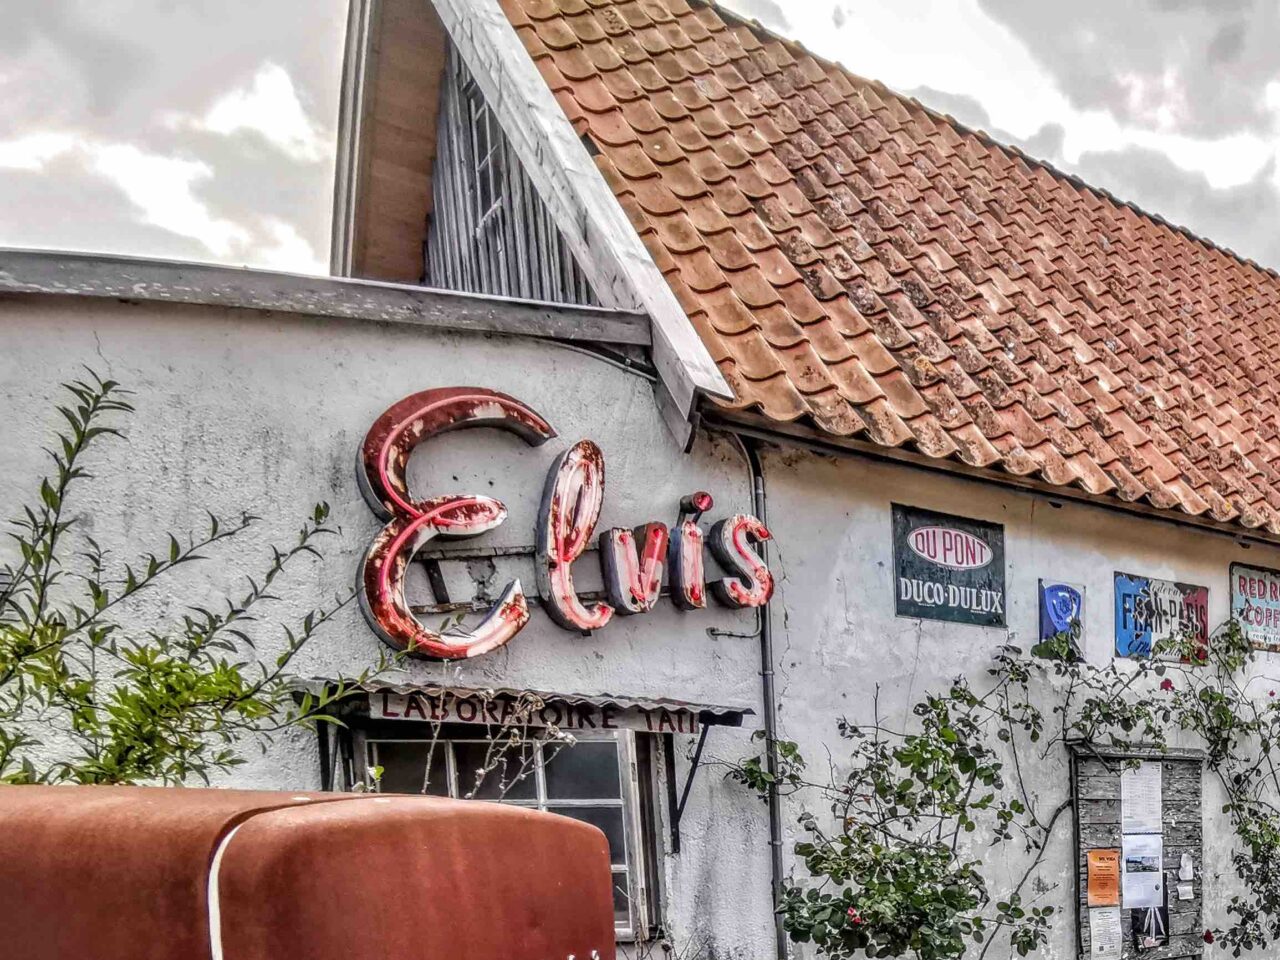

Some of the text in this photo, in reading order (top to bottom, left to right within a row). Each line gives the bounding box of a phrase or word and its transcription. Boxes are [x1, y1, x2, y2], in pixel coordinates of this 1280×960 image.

[357, 386, 774, 661] Elvis
[914, 529, 986, 566] DU PONT
[1238, 574, 1266, 600] RED
[381, 695, 696, 733] LABORATOIRE TATI
